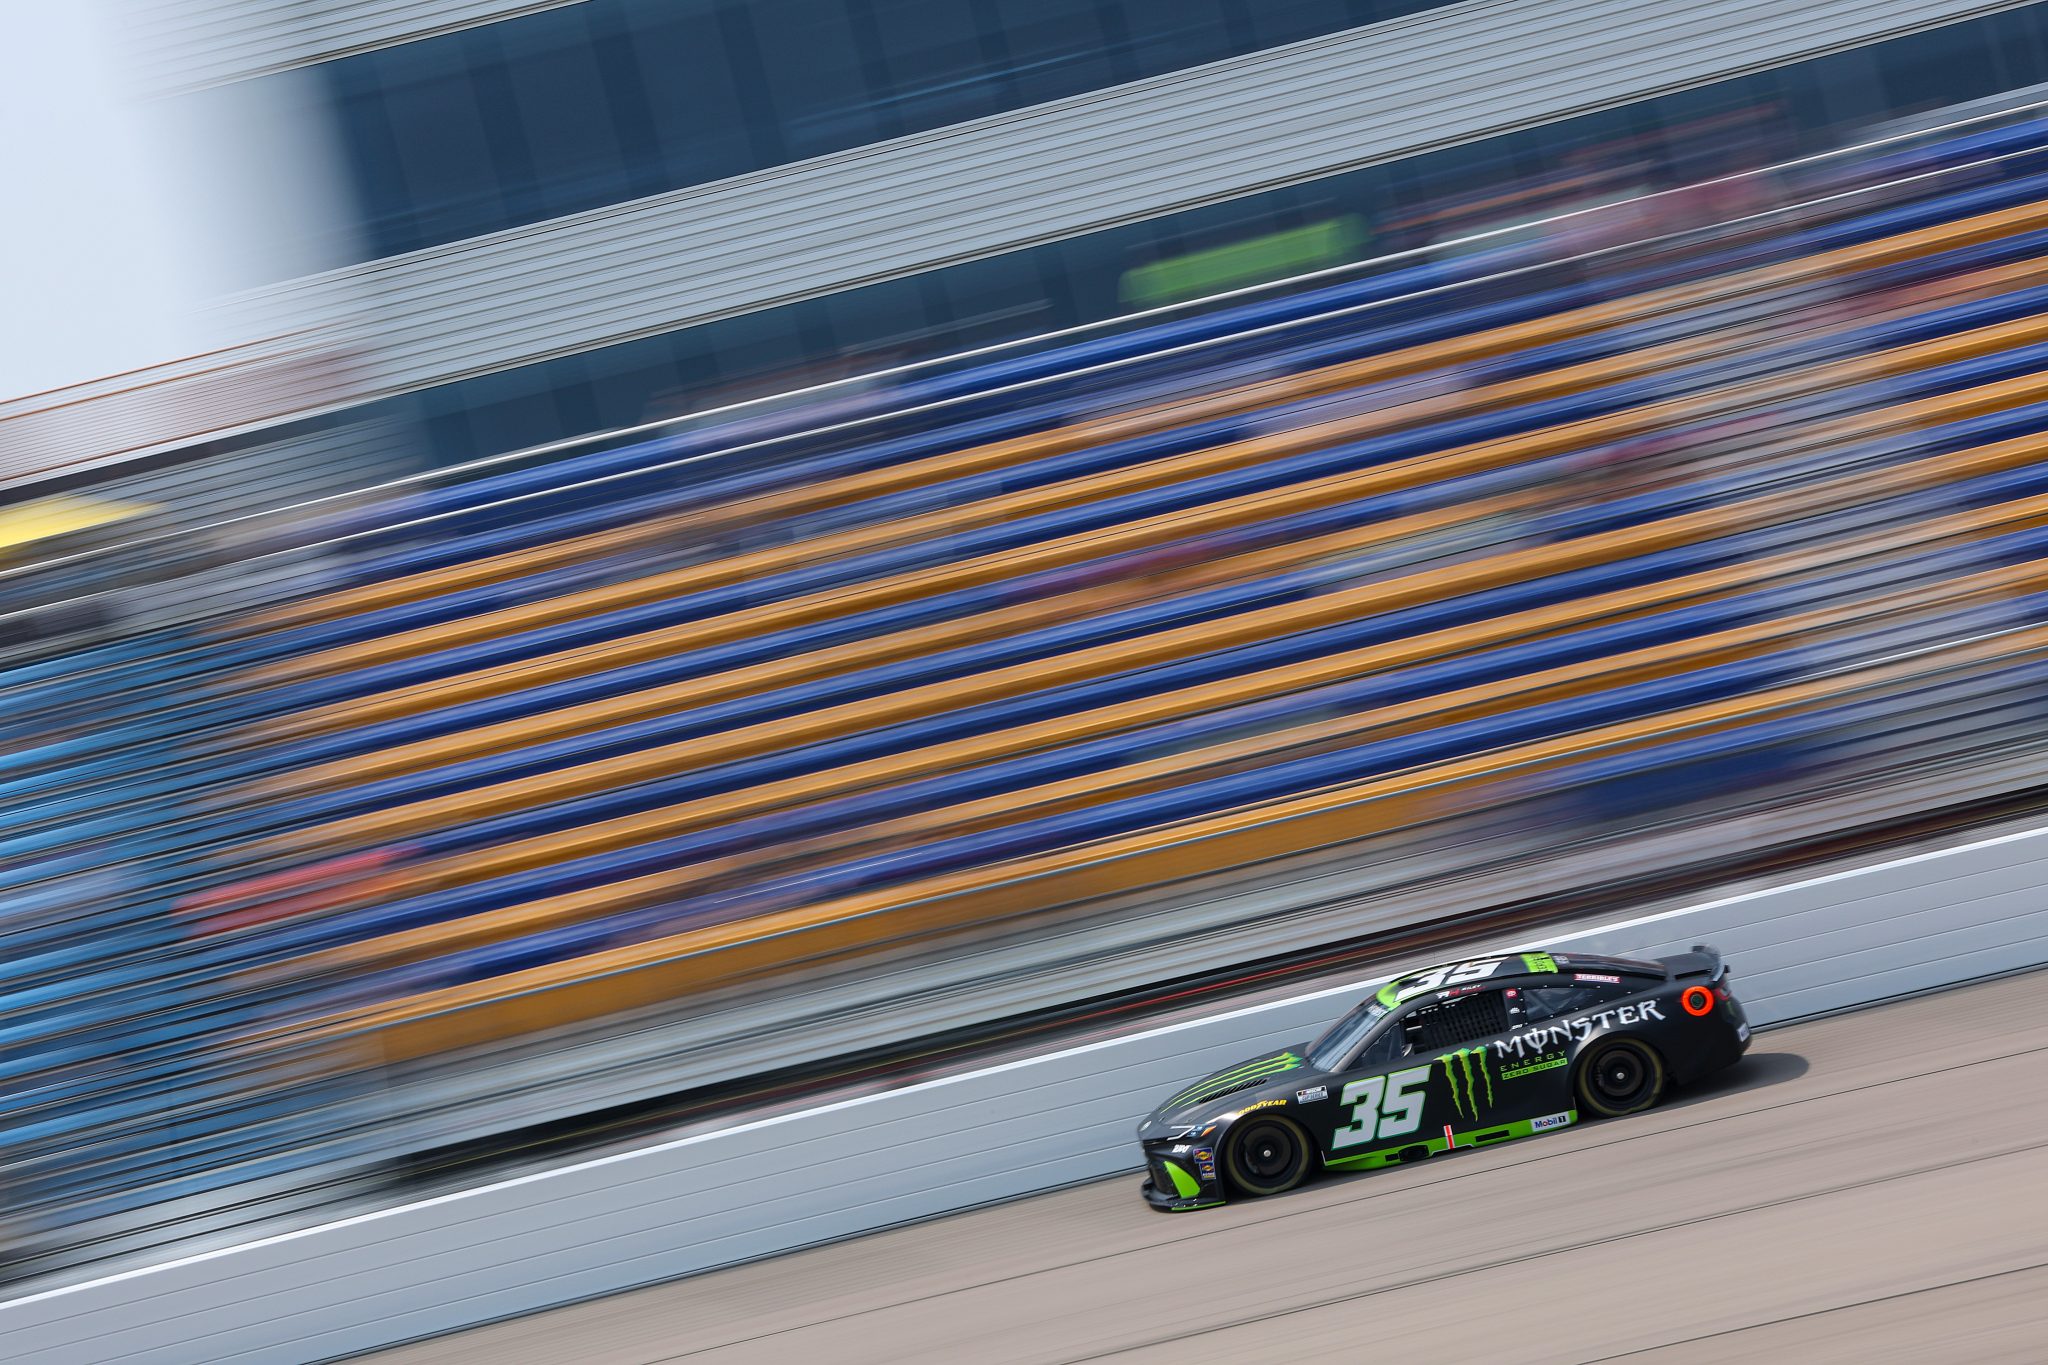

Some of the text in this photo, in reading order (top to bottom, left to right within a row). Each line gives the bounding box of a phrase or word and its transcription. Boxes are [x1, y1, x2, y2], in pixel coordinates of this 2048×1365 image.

[1393, 956, 1511, 1003] 35
[1493, 1000, 1666, 1059] MONSTER
[1500, 1050, 1565, 1071] ENERGY
[1504, 1060, 1566, 1079] ZERO SUGAR
[1331, 1064, 1432, 1150] 35
[1534, 1117, 1558, 1129] Mobil
